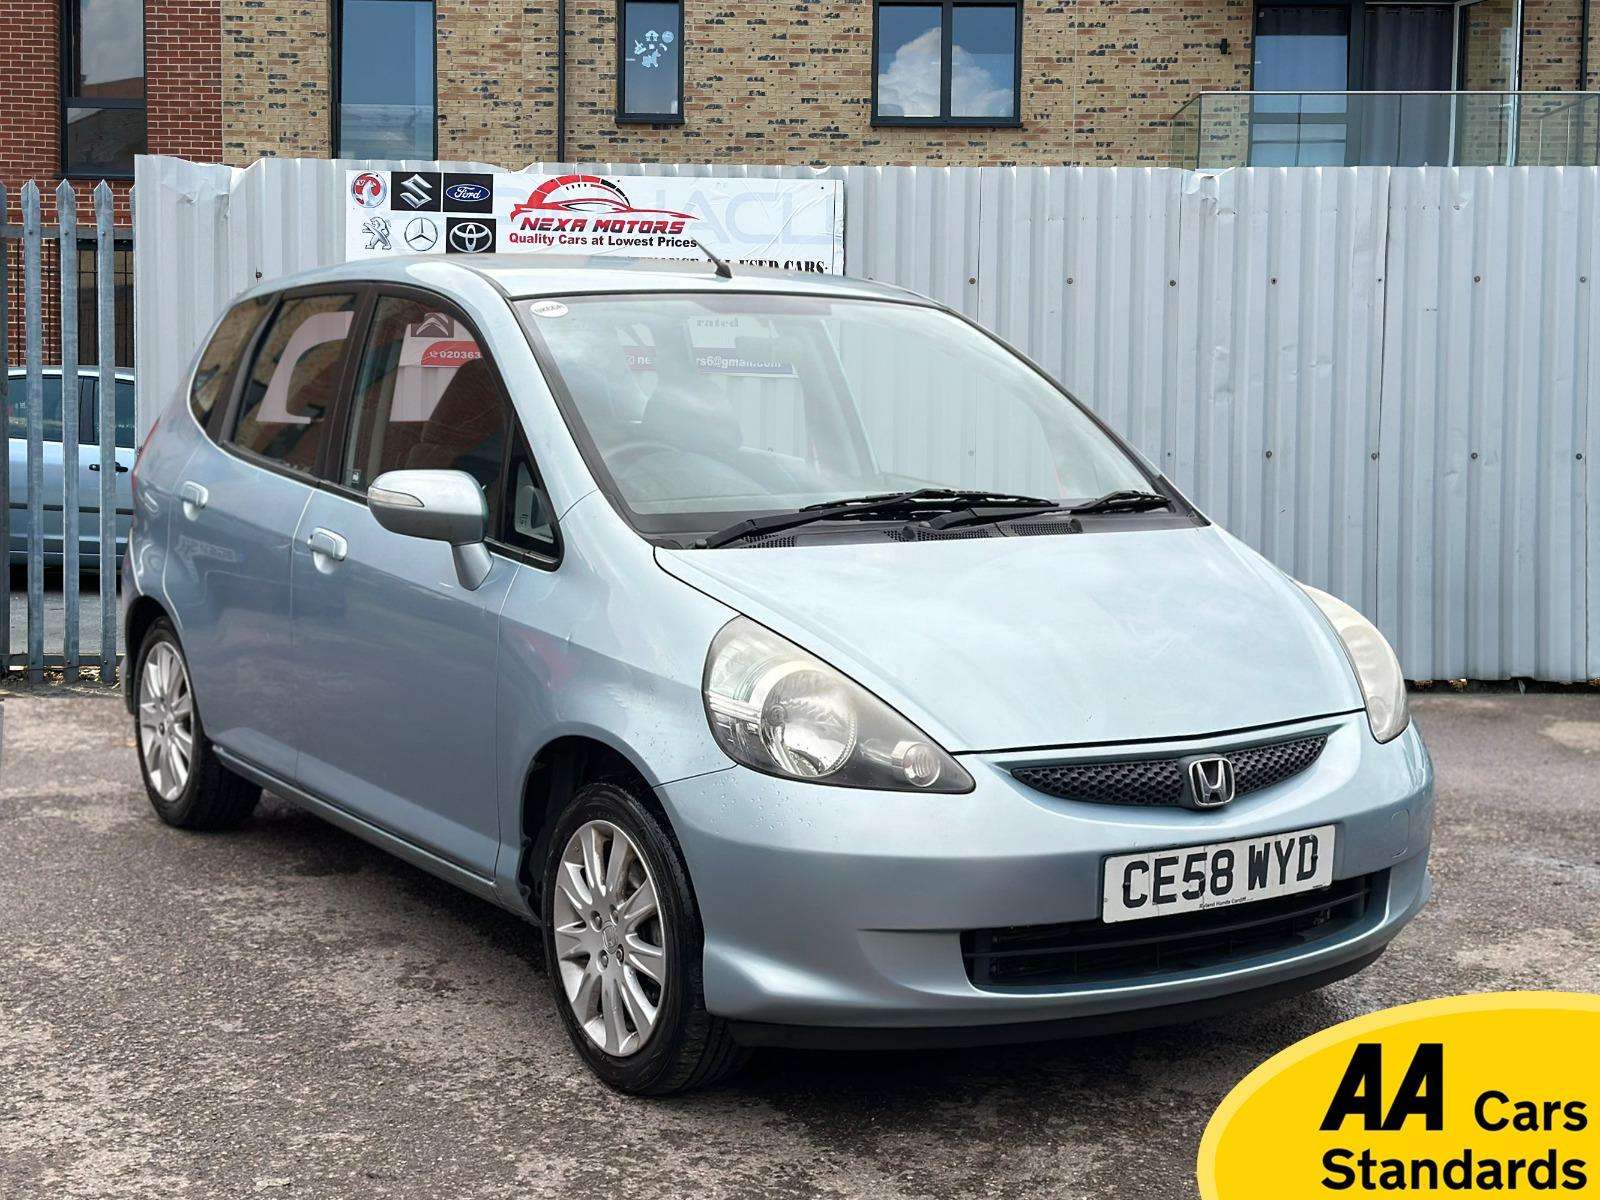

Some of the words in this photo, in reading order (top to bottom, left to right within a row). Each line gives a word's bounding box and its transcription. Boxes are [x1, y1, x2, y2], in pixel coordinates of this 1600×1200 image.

[453, 186, 482, 200] Ford
[520, 217, 588, 232] NEXA
[592, 219, 686, 235] MOTORS
[509, 232, 555, 247] Quality
[559, 234, 588, 245] Cars
[592, 235, 605, 246] at
[608, 236, 654, 247] Lowest
[657, 237, 698, 248] Prices
[1122, 848, 1235, 909] CE58
[1248, 834, 1319, 891] WYD
